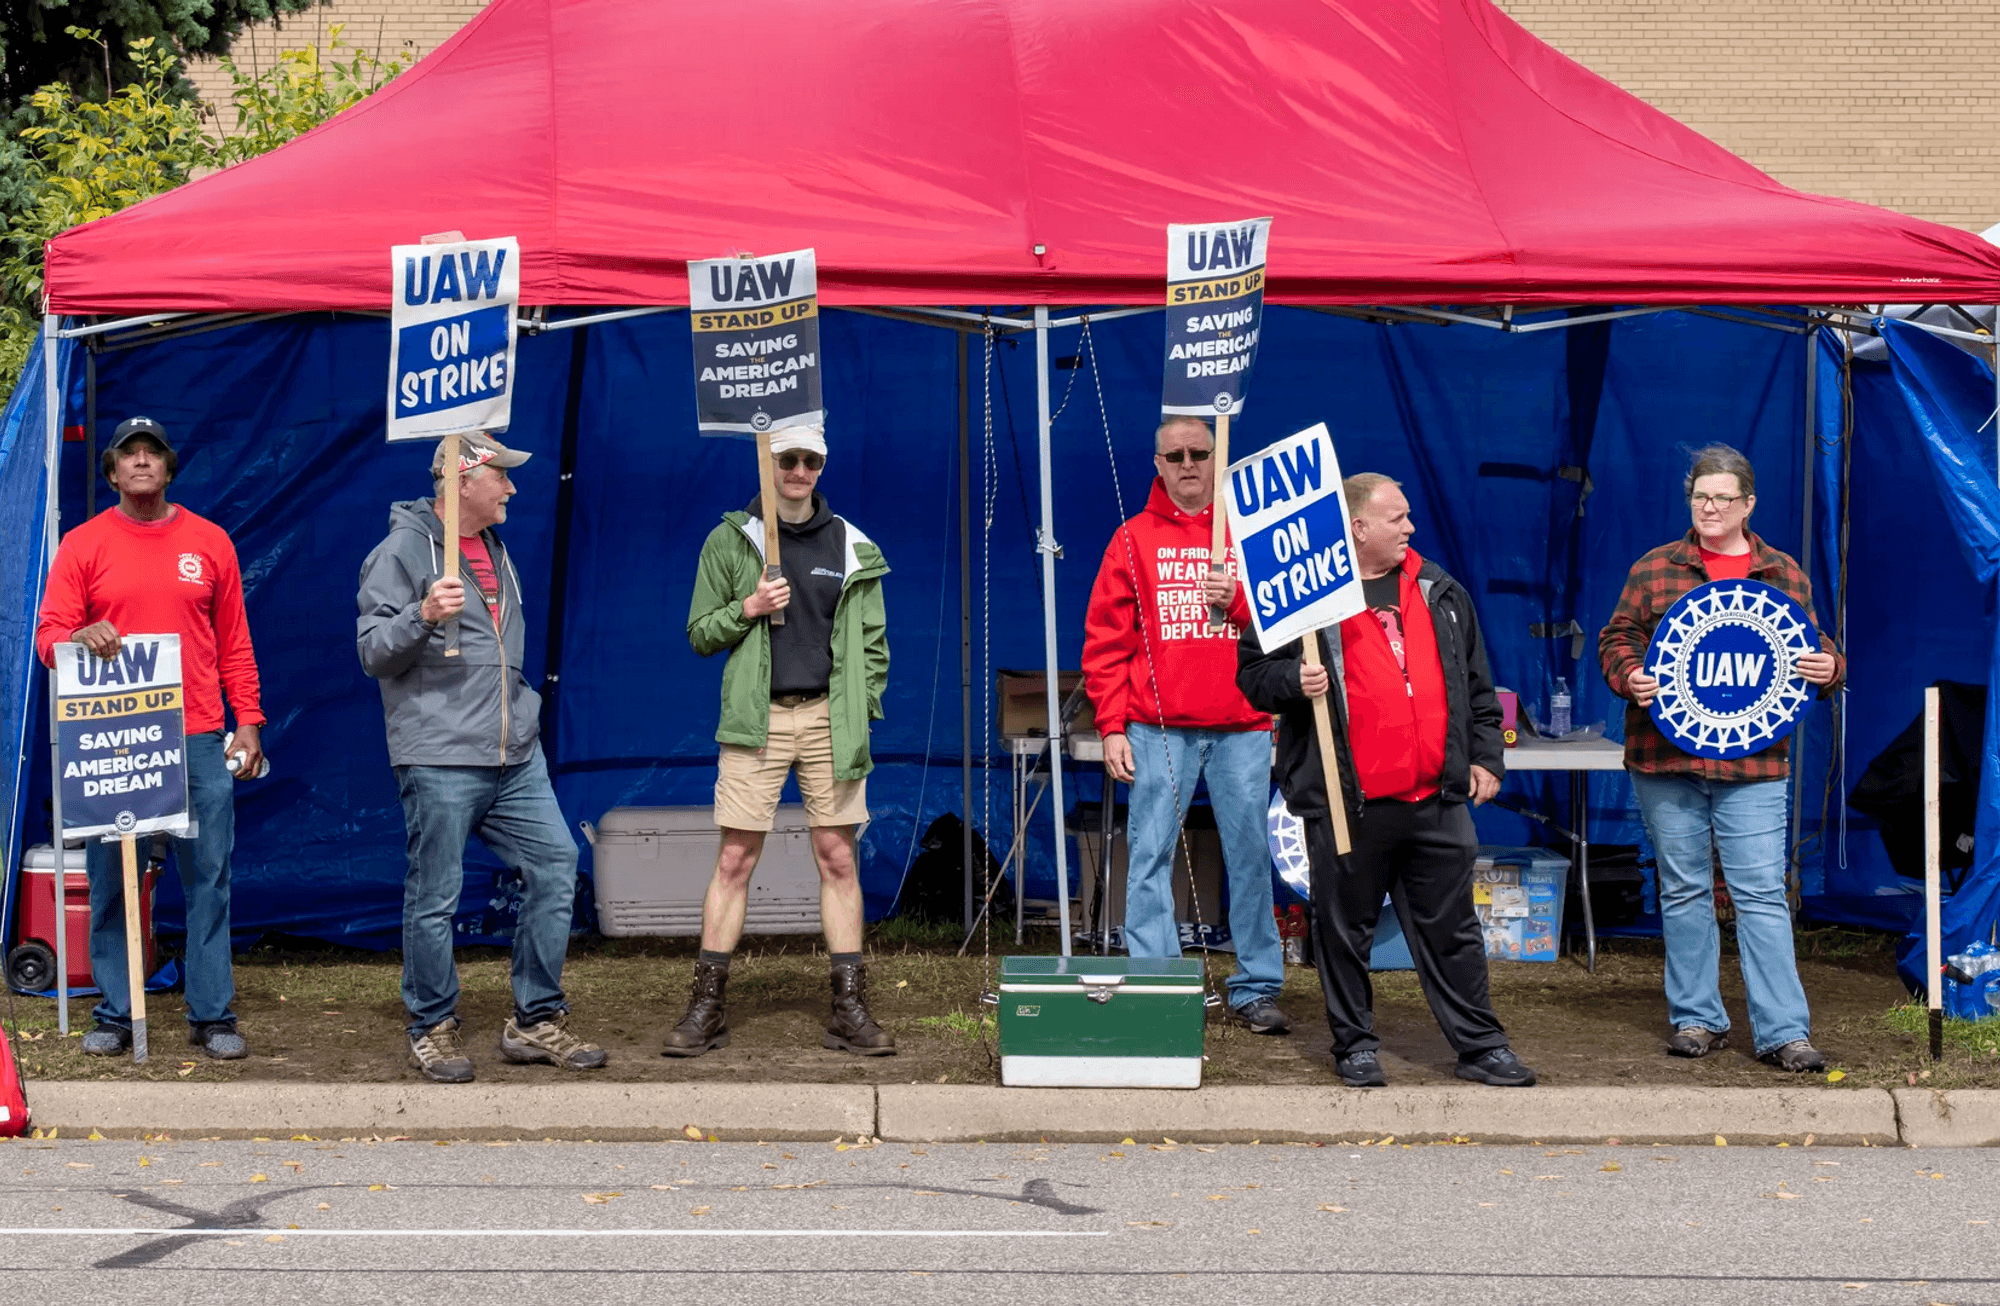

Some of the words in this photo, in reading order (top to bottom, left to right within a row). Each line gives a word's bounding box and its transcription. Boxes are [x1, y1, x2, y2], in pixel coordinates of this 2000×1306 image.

[1188, 225, 1257, 271] UAW
[405, 248, 507, 306] UAW
[710, 258, 796, 302] UAW
[1174, 281, 1240, 302] STAND
[1244, 273, 1261, 291] UP
[700, 311, 774, 329] STAND
[781, 302, 810, 319] UP
[1186, 306, 1252, 333] SAVING
[430, 320, 470, 361] ON
[715, 333, 798, 358] SAVING
[1168, 328, 1259, 360] AMERICAN
[700, 352, 815, 382] AMERICAN
[1186, 352, 1250, 378] DREAM
[400, 352, 506, 408] STRIKE
[719, 375, 798, 399] DREAM
[1231, 437, 1321, 517] UAW
[1157, 547, 1176, 559] ON
[1272, 517, 1310, 564] ON
[1157, 562, 1208, 581] WEAR
[1257, 539, 1350, 617] STRIKE
[1161, 622, 1241, 640] DEPLOYE
[1704, 615, 1718, 625] AND
[1719, 611, 1766, 626] AGRICULTURAL
[1679, 625, 1703, 656] AEROSPACE
[1765, 624, 1788, 657] IMPLEMENT
[76, 641, 159, 687] UAW
[1696, 652, 1767, 687] UAW
[1777, 659, 1788, 688] WORKERS
[65, 699, 138, 717] STAND
[145, 692, 175, 708] UP
[1684, 701, 1702, 719] UNITED
[1748, 700, 1773, 719] AMERICA
[79, 725, 163, 750] SAVING
[63, 749, 181, 778] AMERICAN
[83, 771, 163, 797] DREAM
